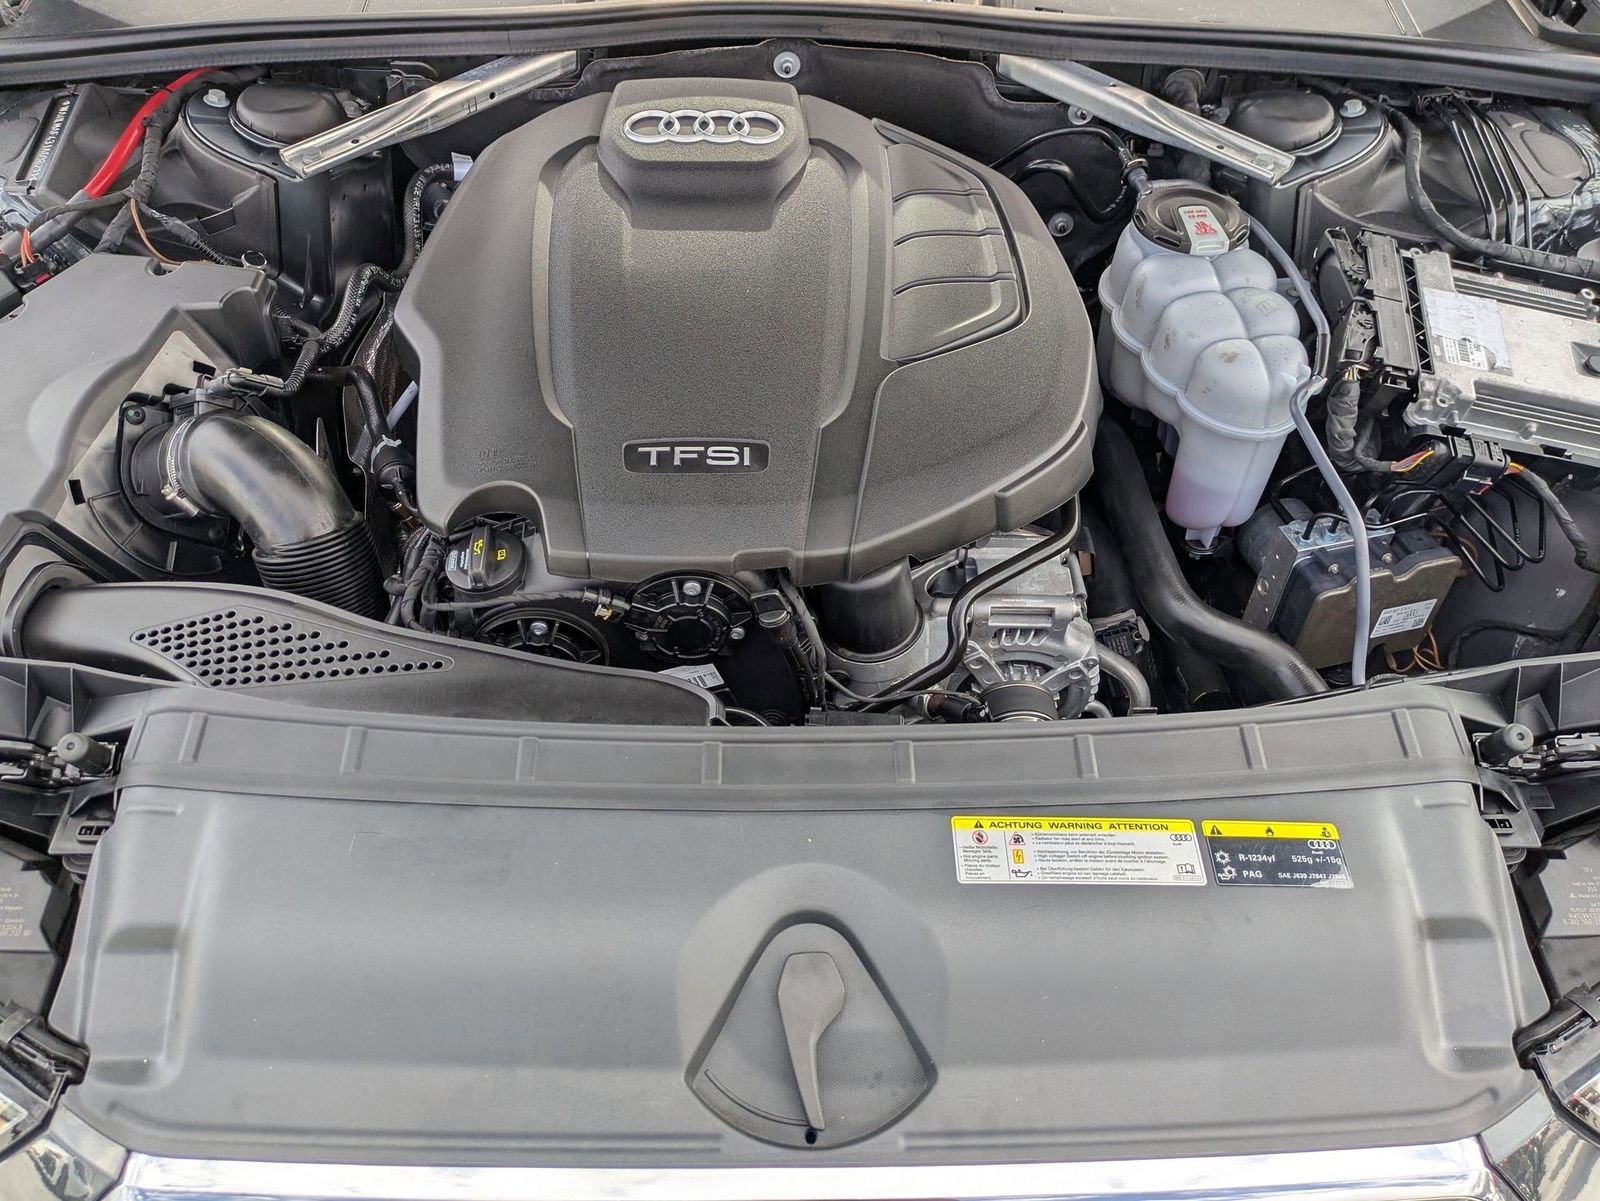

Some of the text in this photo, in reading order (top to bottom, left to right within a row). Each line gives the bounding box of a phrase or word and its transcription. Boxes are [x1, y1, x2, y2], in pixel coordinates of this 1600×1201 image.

[638, 446, 750, 466] TFSI
[989, 821, 1168, 831] ACHTUNG WARNING ATTENTION
[1292, 855, 1313, 864] 525g
[1315, 856, 1342, 864] +/-15g
[1242, 870, 1262, 878] PAG
